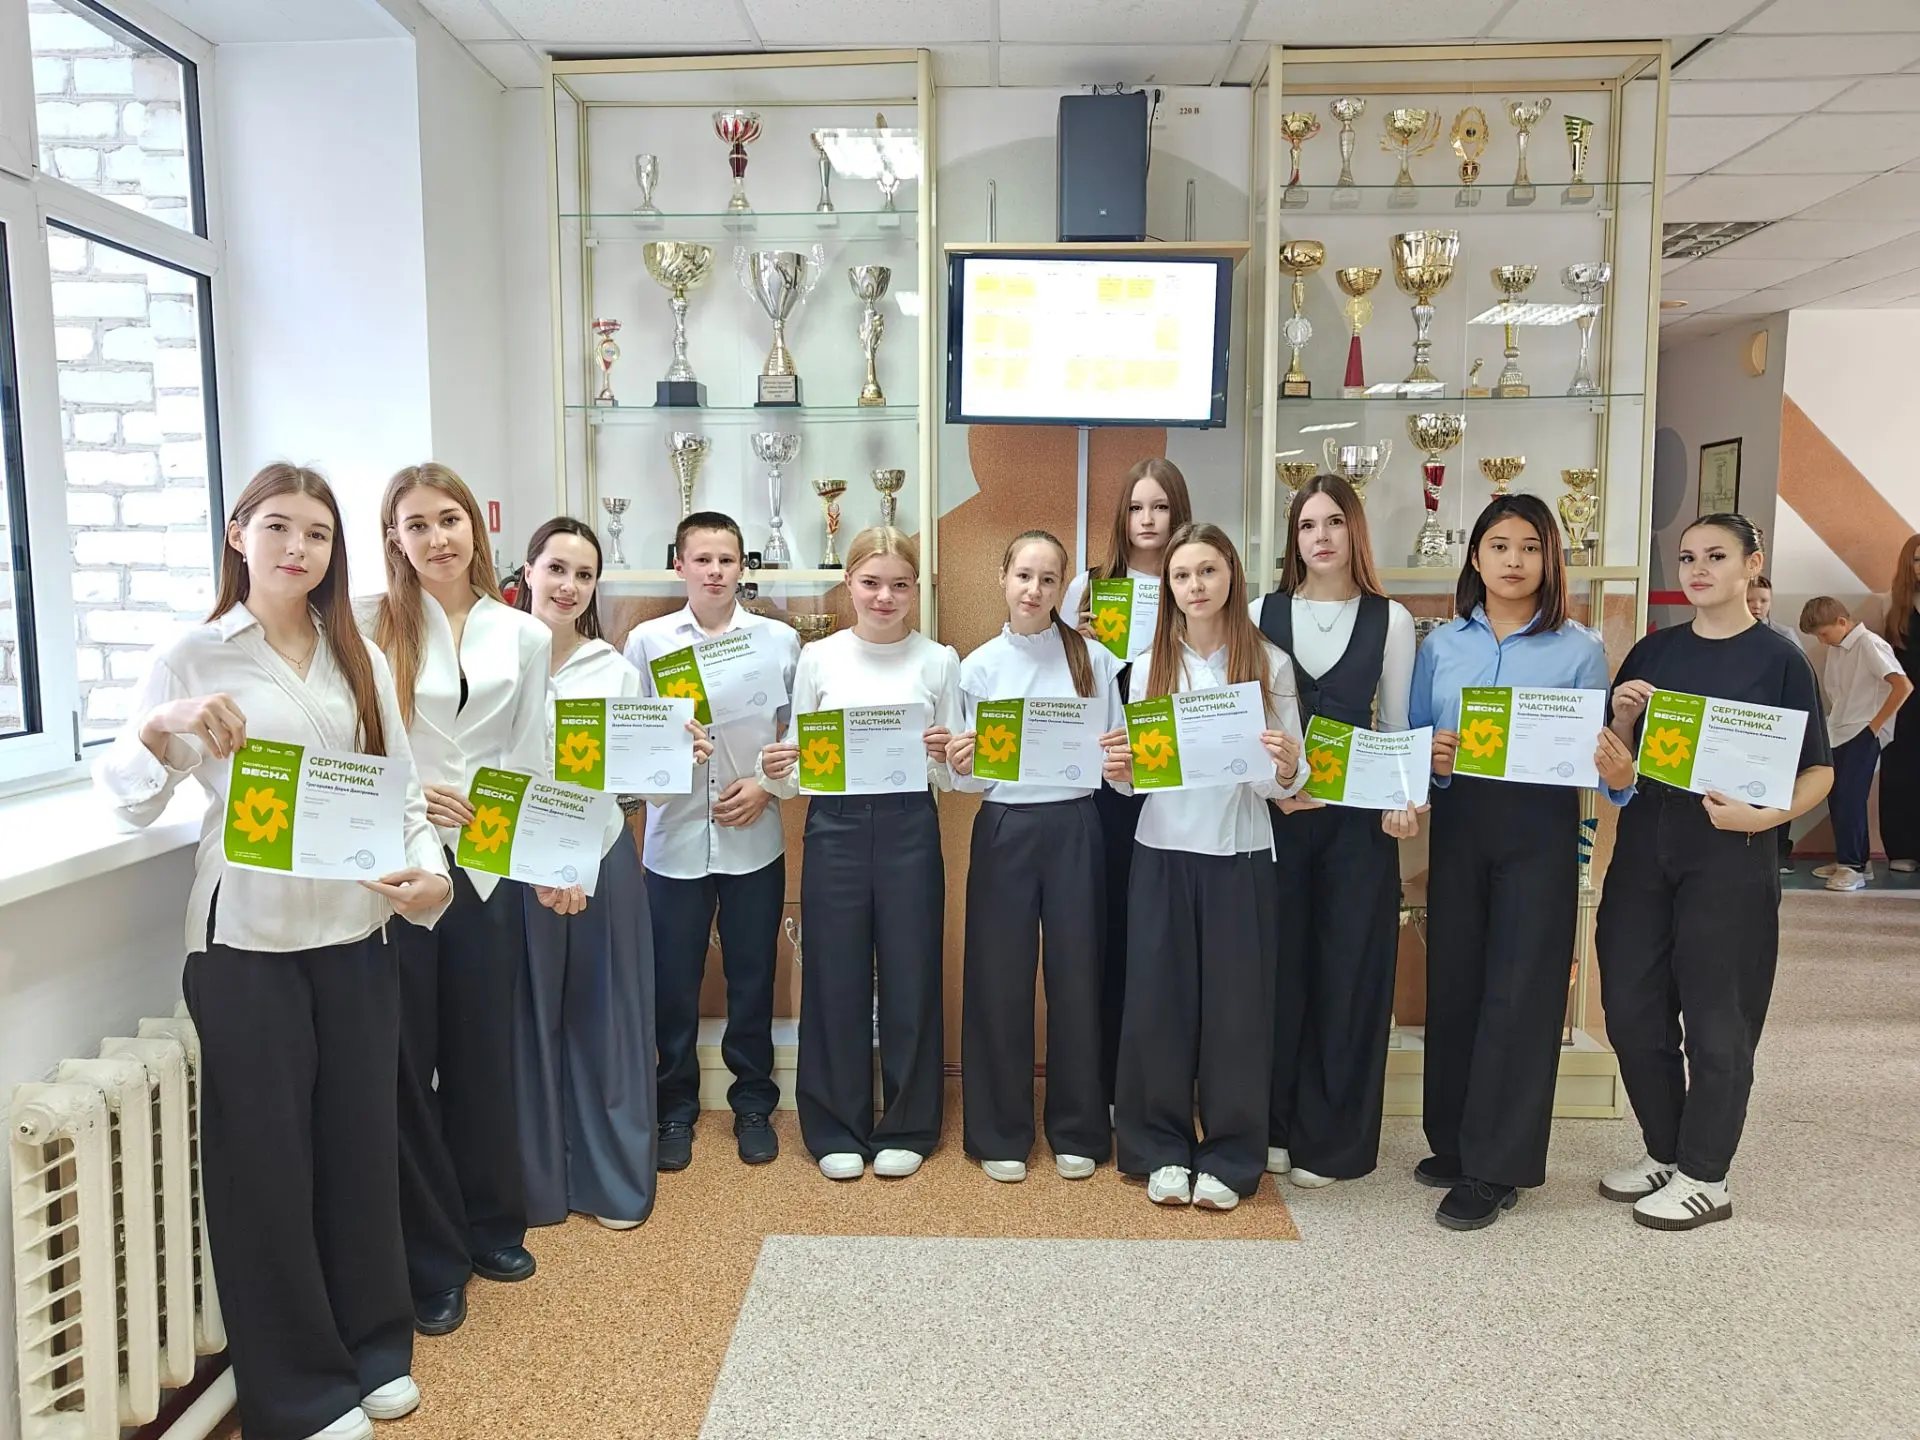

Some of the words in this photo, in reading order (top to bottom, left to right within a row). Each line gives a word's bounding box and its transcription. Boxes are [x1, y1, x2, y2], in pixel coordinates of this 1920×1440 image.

[699, 633, 752, 653] СЕРТИФИКАТ
[701, 644, 750, 661] УЧАСТНИКА
[658, 664, 692, 678] ВЕСНА
[1178, 690, 1241, 704] СЕРТИФИКАТ
[1518, 692, 1584, 703] СЕРТИФИКАТ
[612, 704, 674, 712] СЕРТИФИКАТ
[1030, 702, 1088, 710] СЕРТИФИКАТ
[1180, 701, 1236, 714] УЧАСТНИКА
[1466, 705, 1504, 713] ВЕСНА
[1518, 702, 1576, 713] УЧАСТНИКА
[849, 709, 907, 718] СЕРТИФИКАТ
[1030, 710, 1080, 718] УЧАСТНИКА
[1653, 712, 1695, 724] ВЕСНА
[1712, 704, 1784, 722] СЕРТИФИКАТ
[561, 718, 600, 726] ВЕСНА
[850, 718, 901, 726] УЧАСТНИКА
[1132, 715, 1169, 725] ВЕСНА
[1710, 714, 1773, 732] УЧАСТНИКА
[1358, 733, 1416, 743] СЕРТИФИКАТ
[1357, 742, 1410, 750] УЧАСТНИКА
[310, 756, 385, 776] СЕРТИФИКАТ
[242, 767, 290, 782] ВЕСНА
[308, 769, 375, 788] УЧАСТНИКА
[476, 787, 516, 803] ВЕСНА
[534, 784, 596, 804] СЕРТИФИКАТ
[530, 794, 585, 813] УЧАСТНИКА
